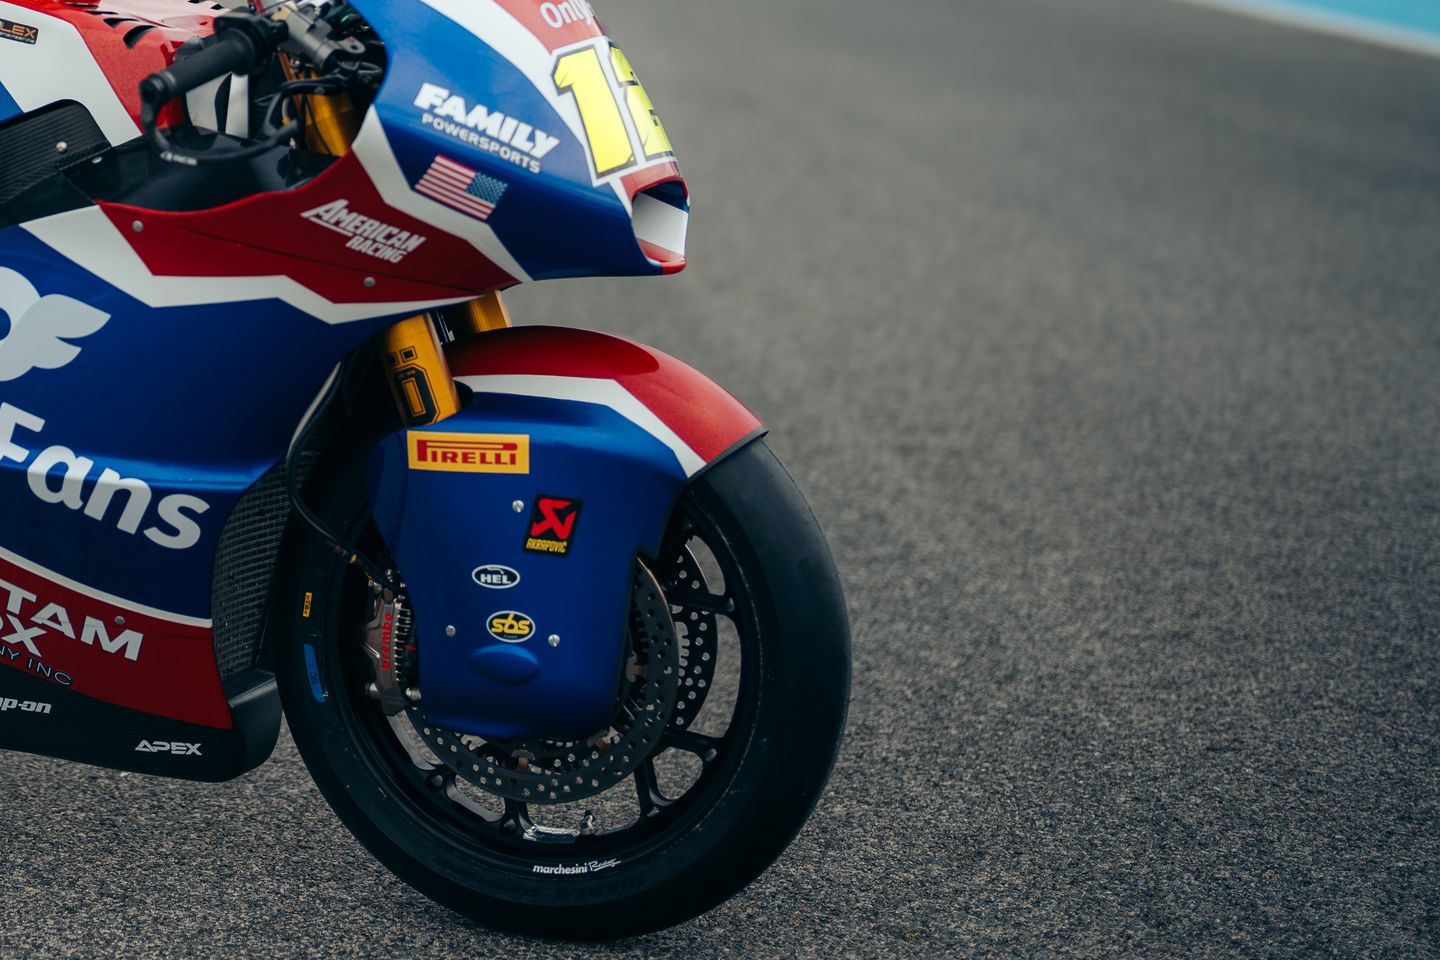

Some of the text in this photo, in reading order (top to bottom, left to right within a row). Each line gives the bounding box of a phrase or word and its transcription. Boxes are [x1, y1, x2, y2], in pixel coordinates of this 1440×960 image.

[413, 81, 560, 159] FAMILY
[421, 112, 542, 175] POWERSPORTS
[300, 197, 427, 254] AMERICAN
[346, 234, 409, 265] RACING
[416, 439, 519, 466] PIRELLI
[479, 573, 512, 585] HEL
[490, 612, 531, 635] sbs
[380, 612, 393, 672] brembo
[27, 657, 73, 687] INC
[134, 739, 204, 757] APEX
[532, 862, 589, 875] marchesini
